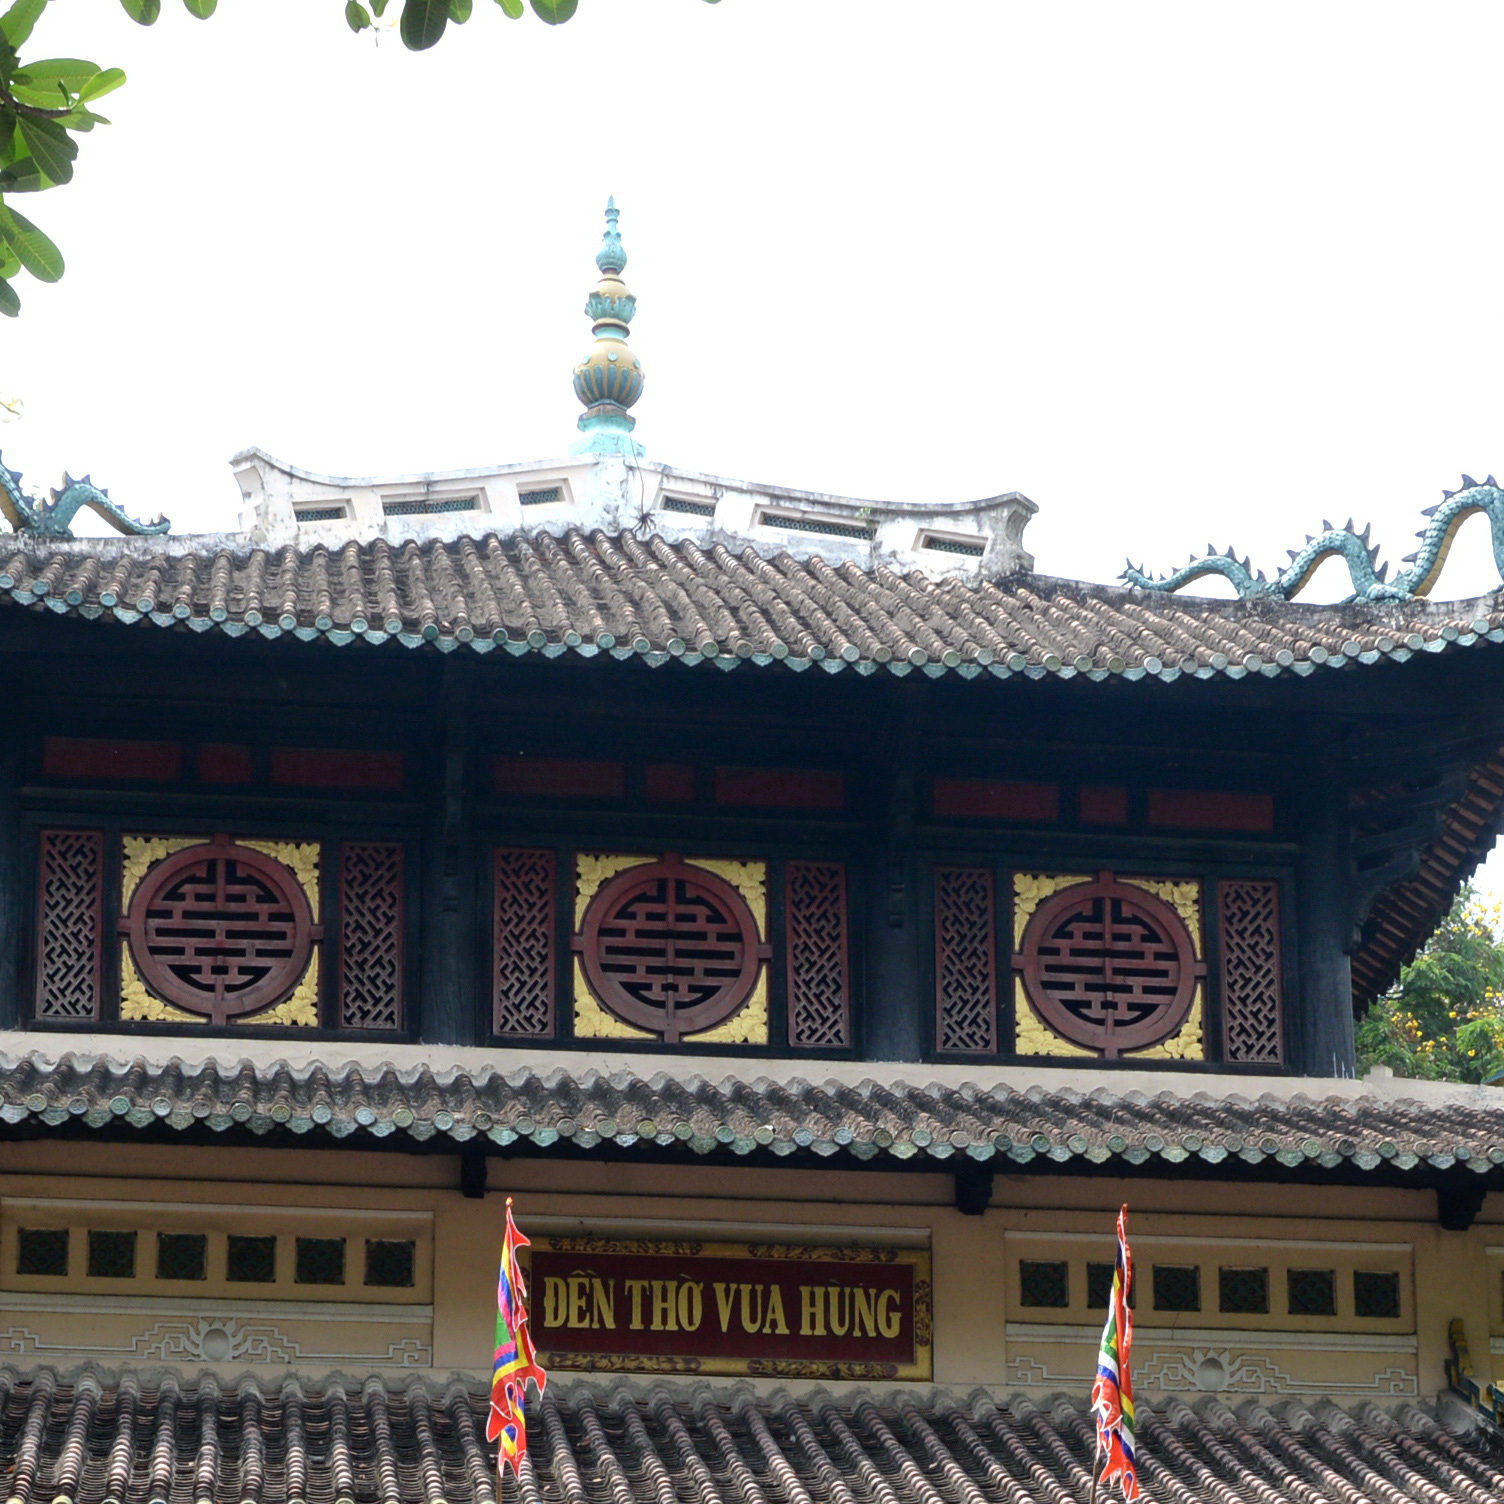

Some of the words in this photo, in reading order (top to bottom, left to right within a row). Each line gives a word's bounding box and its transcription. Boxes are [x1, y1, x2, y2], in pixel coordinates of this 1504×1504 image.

[543, 1269, 616, 1330] ĐỀN
[624, 1273, 704, 1332] THỜ
[712, 1282, 790, 1334] VUA
